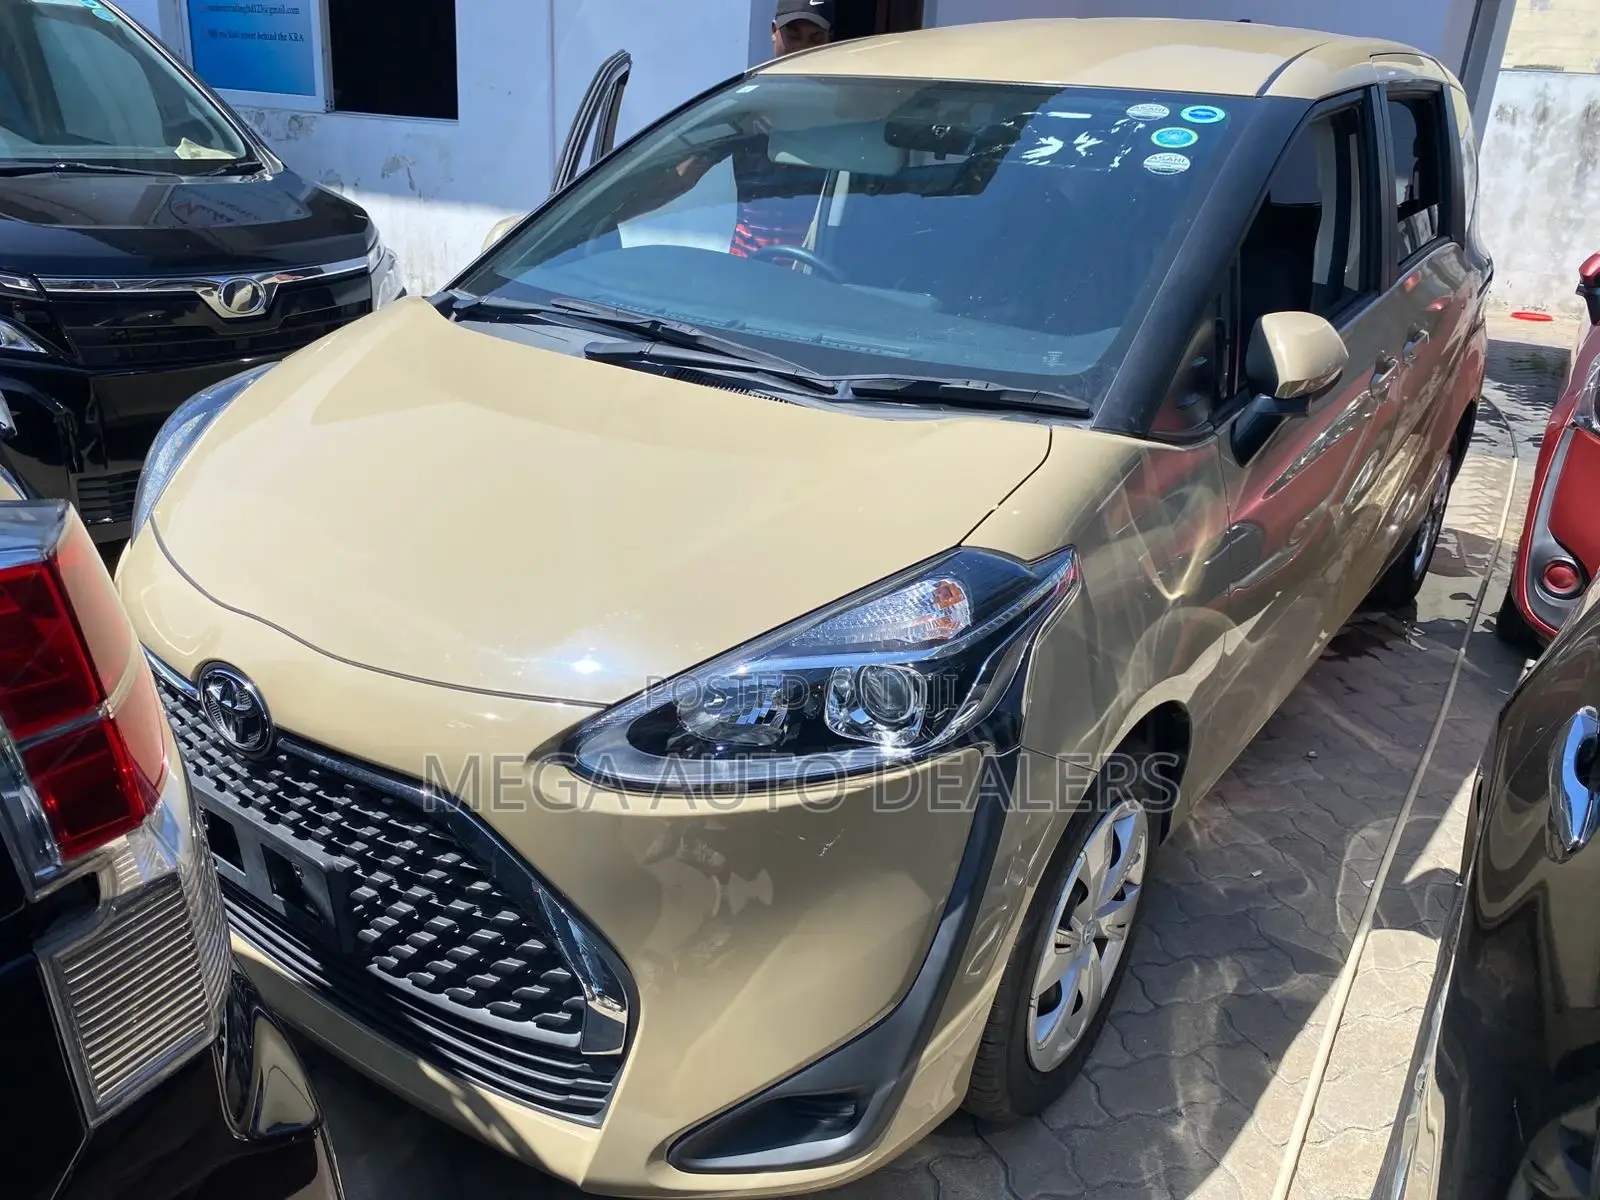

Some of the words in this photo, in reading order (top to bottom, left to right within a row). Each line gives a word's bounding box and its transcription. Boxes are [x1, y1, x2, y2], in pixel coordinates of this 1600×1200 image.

[257, 31, 277, 41] behind
[278, 32, 288, 41] the
[288, 32, 304, 43] KRA
